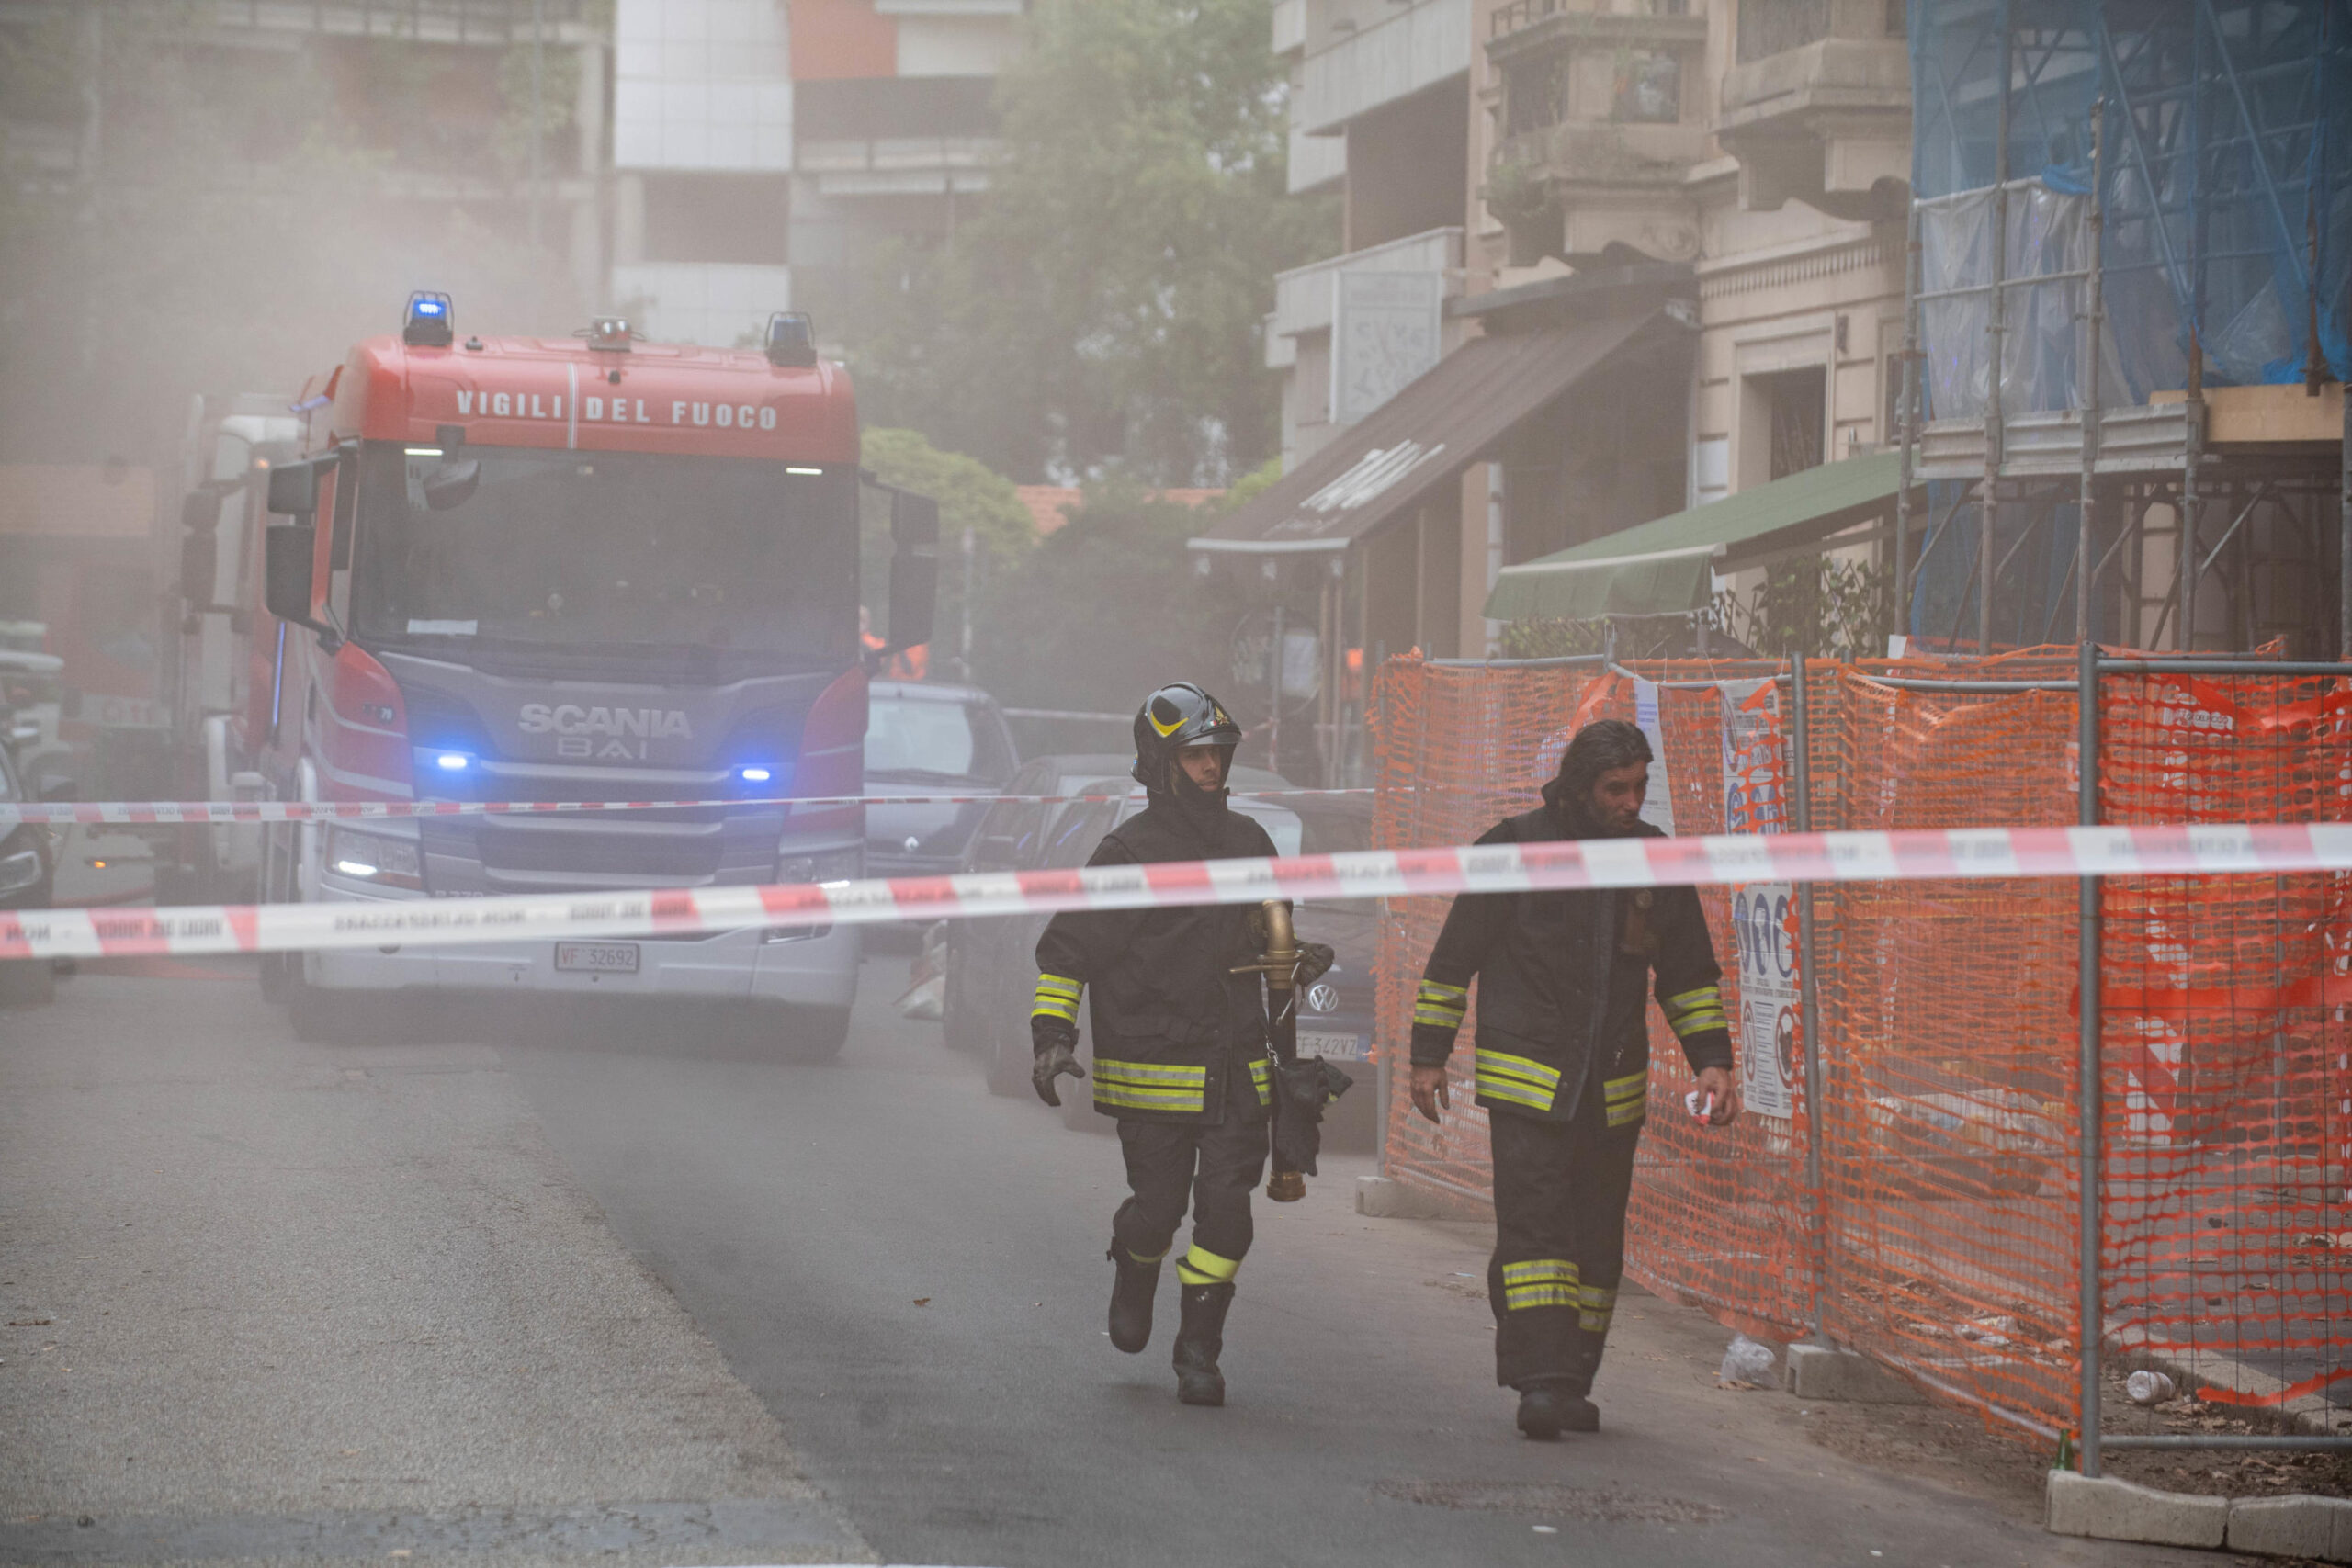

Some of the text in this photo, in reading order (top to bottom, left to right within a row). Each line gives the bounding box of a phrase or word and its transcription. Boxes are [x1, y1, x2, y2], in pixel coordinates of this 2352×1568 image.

[457, 390, 777, 430] VIGILI DEL FUOCO
[517, 704, 693, 739] SCANIA
[556, 737, 647, 760] BAI
[560, 947, 634, 966] VF 32692
